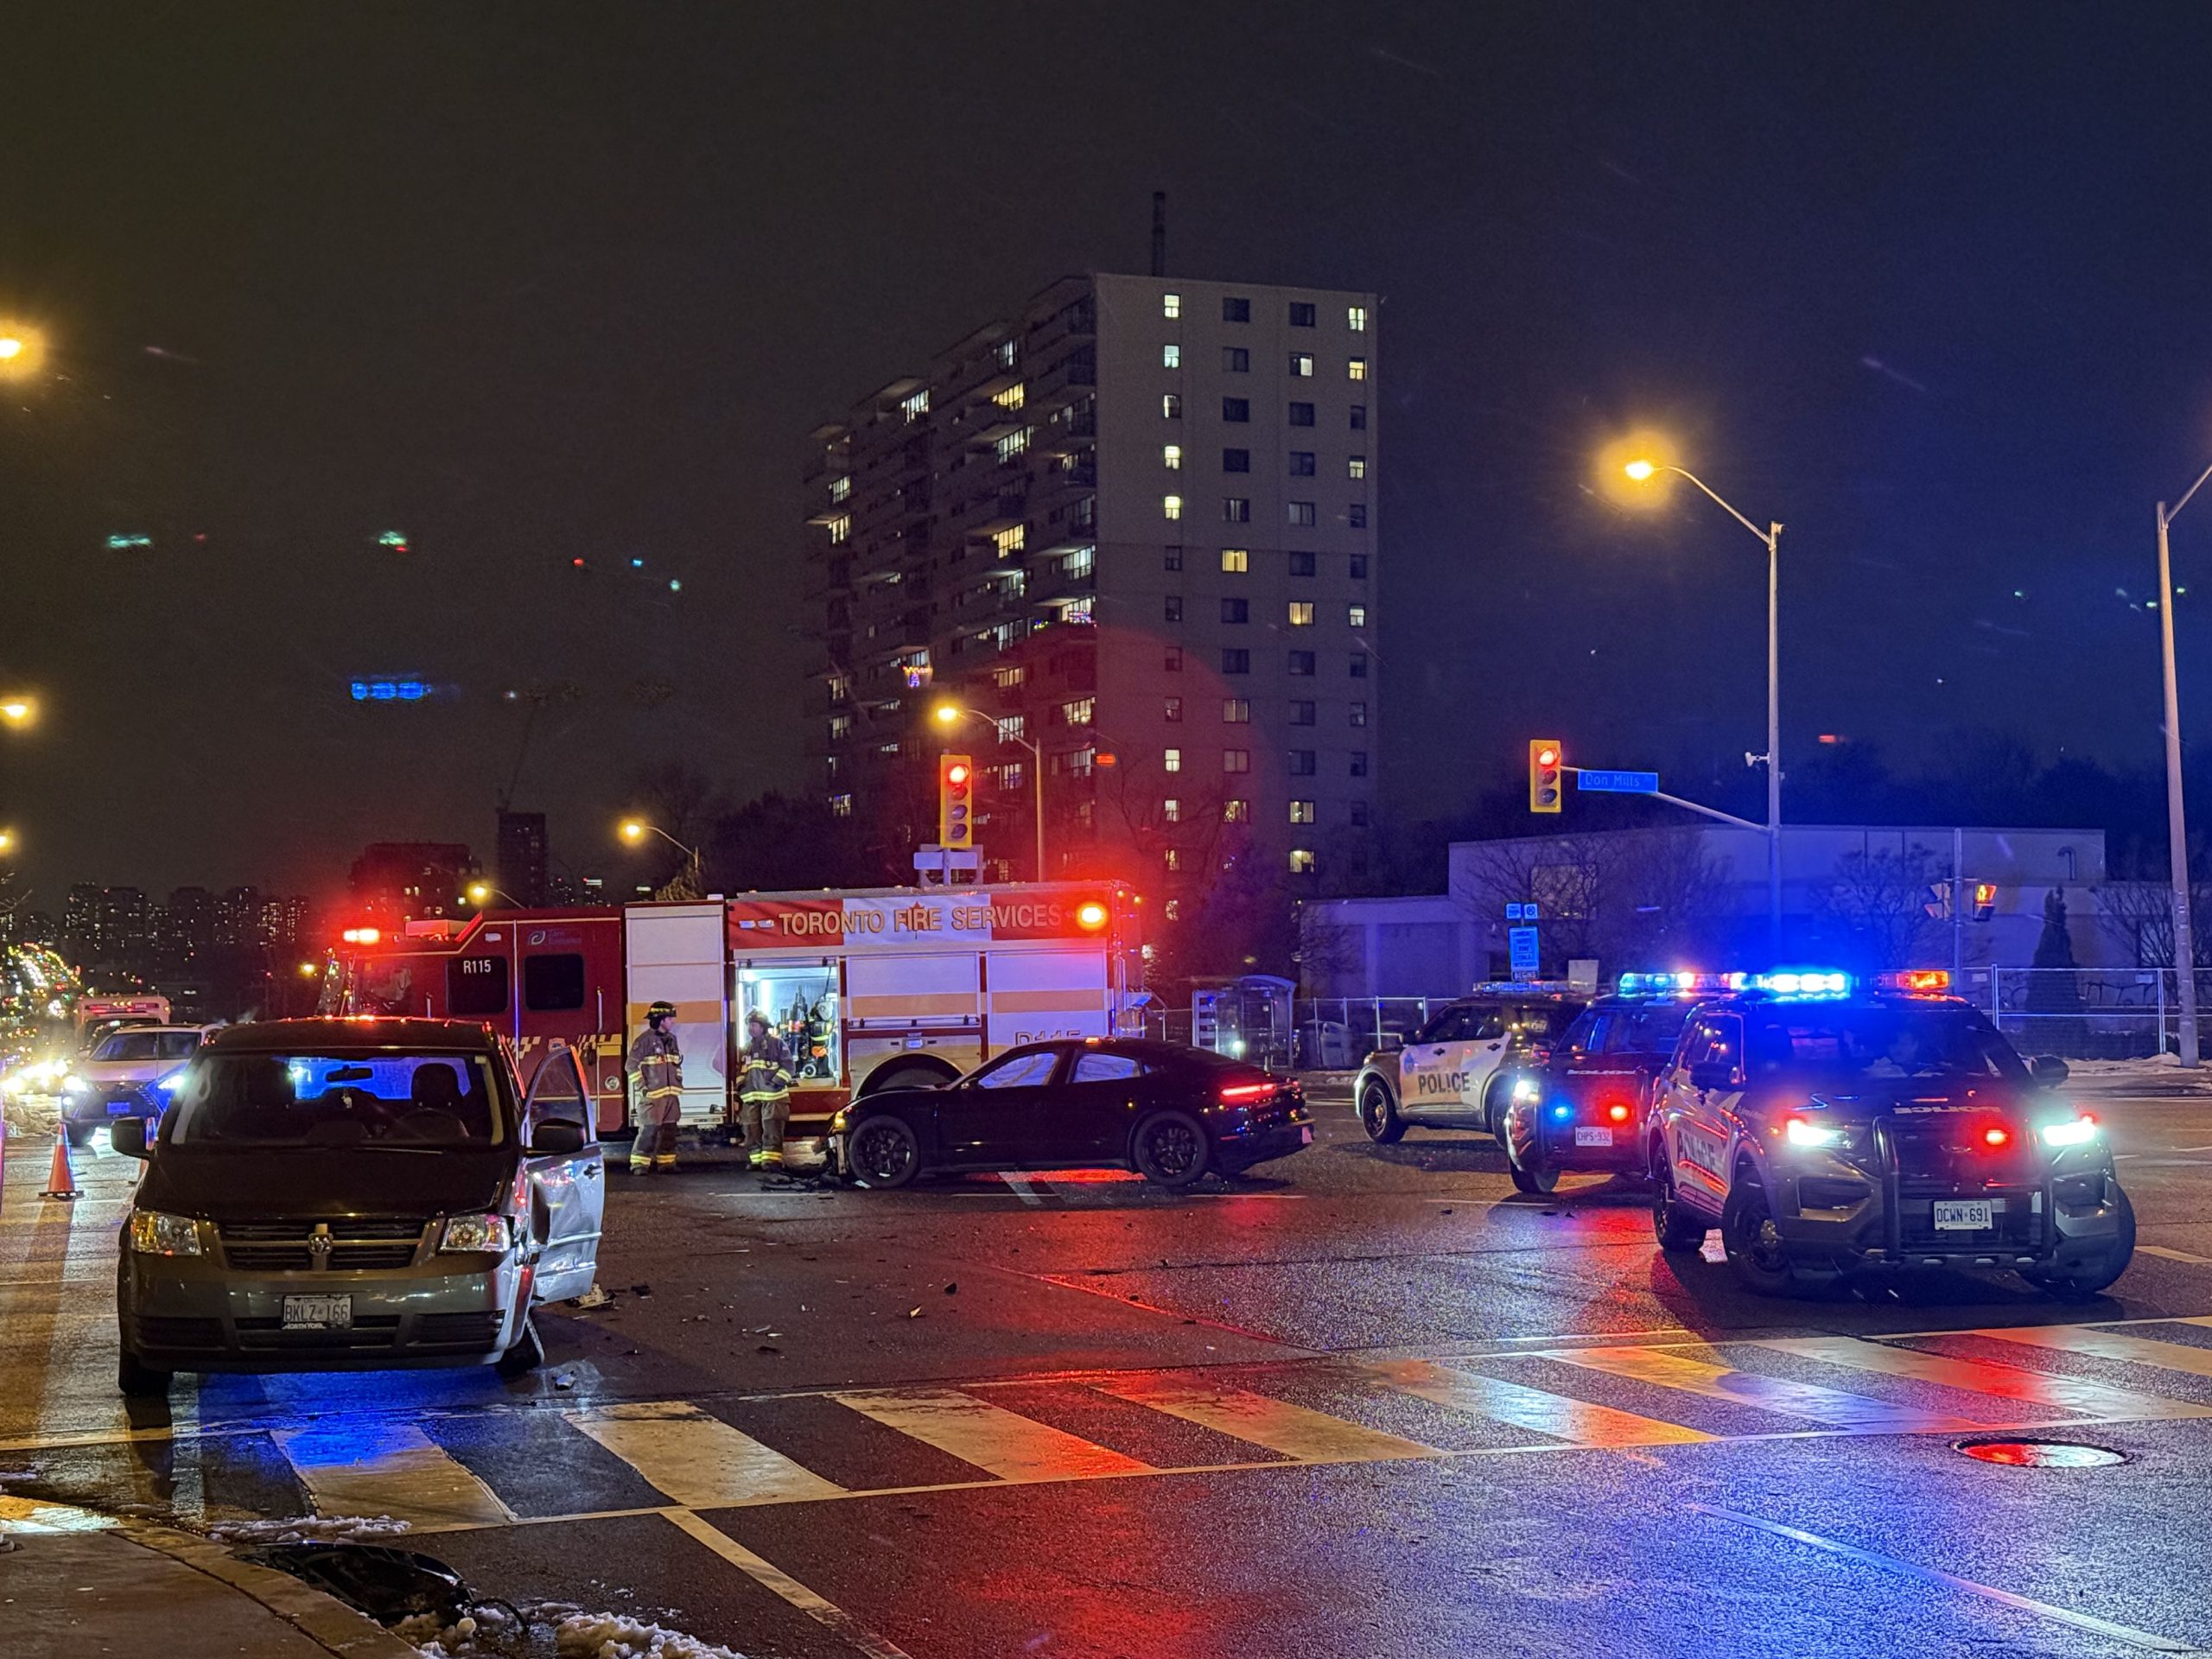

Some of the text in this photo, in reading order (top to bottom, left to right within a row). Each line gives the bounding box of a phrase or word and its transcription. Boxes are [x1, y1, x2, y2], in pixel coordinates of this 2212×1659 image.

[1585, 772, 1608, 786] Don
[1613, 774, 1640, 787] Mills
[779, 904, 1063, 936] TORONTO FIRE SERVICES
[463, 959, 492, 974] R115
[1418, 1071, 1471, 1095] POLICE
